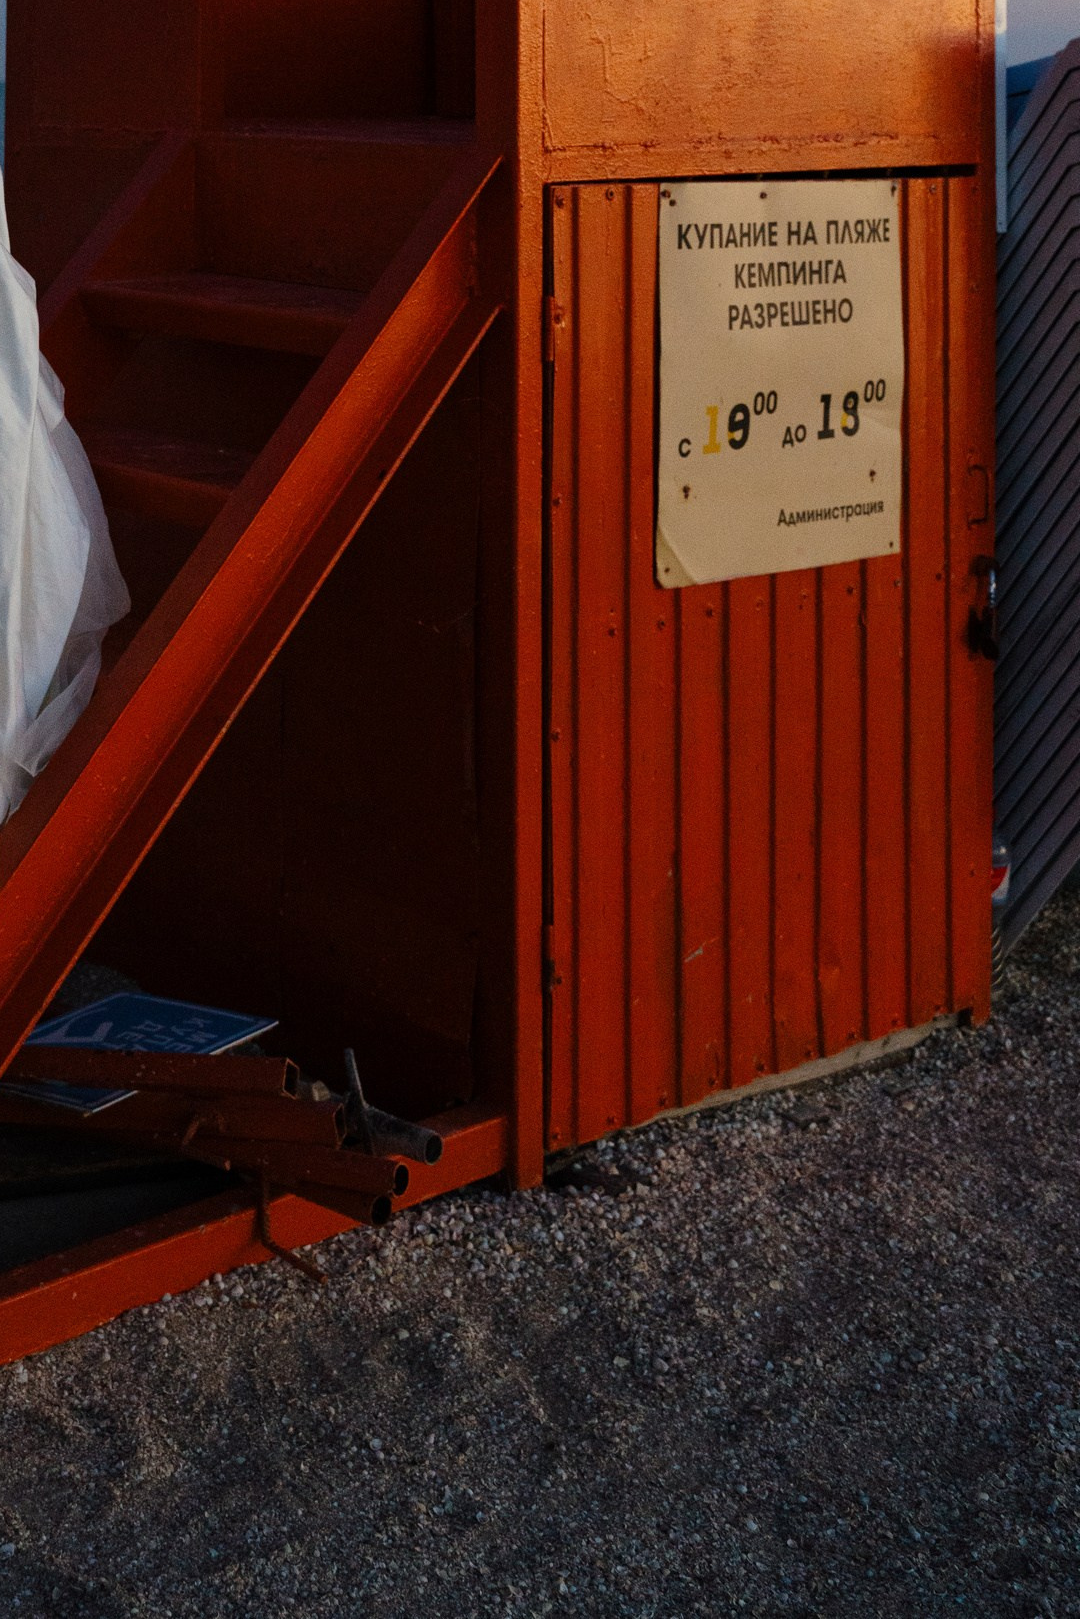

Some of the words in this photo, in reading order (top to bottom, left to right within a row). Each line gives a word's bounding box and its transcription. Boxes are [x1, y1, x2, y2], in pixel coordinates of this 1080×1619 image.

[677, 221, 778, 250] КУПАНИЕ
[787, 219, 818, 247] НА
[826, 217, 891, 245] ПЛЯЖЕ
[734, 259, 848, 289] КЕМПИНГА
[728, 297, 854, 331] РАЗРЕШЕНО
[781, 423, 808, 449] до
[776, 500, 885, 528] Администрация
